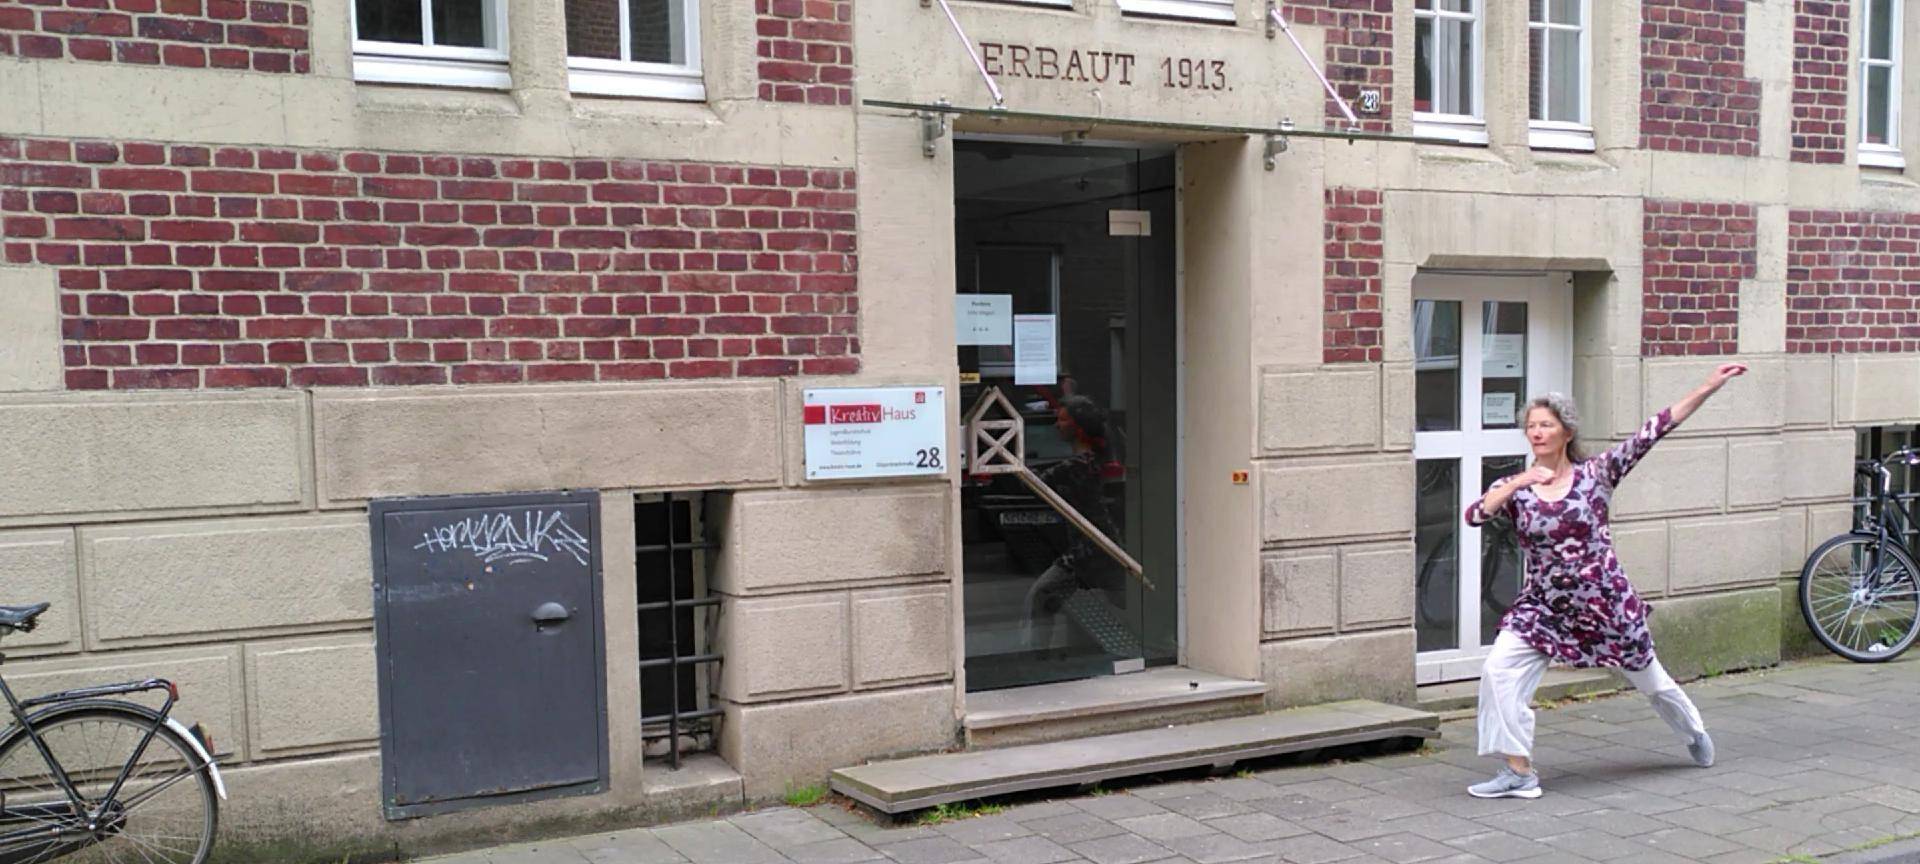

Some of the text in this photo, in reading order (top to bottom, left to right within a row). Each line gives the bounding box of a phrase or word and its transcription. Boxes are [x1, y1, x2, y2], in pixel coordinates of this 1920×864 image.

[979, 42, 1234, 92] ERBAUT 1913.
[1363, 93, 1379, 110] 28
[916, 447, 941, 468] 28
